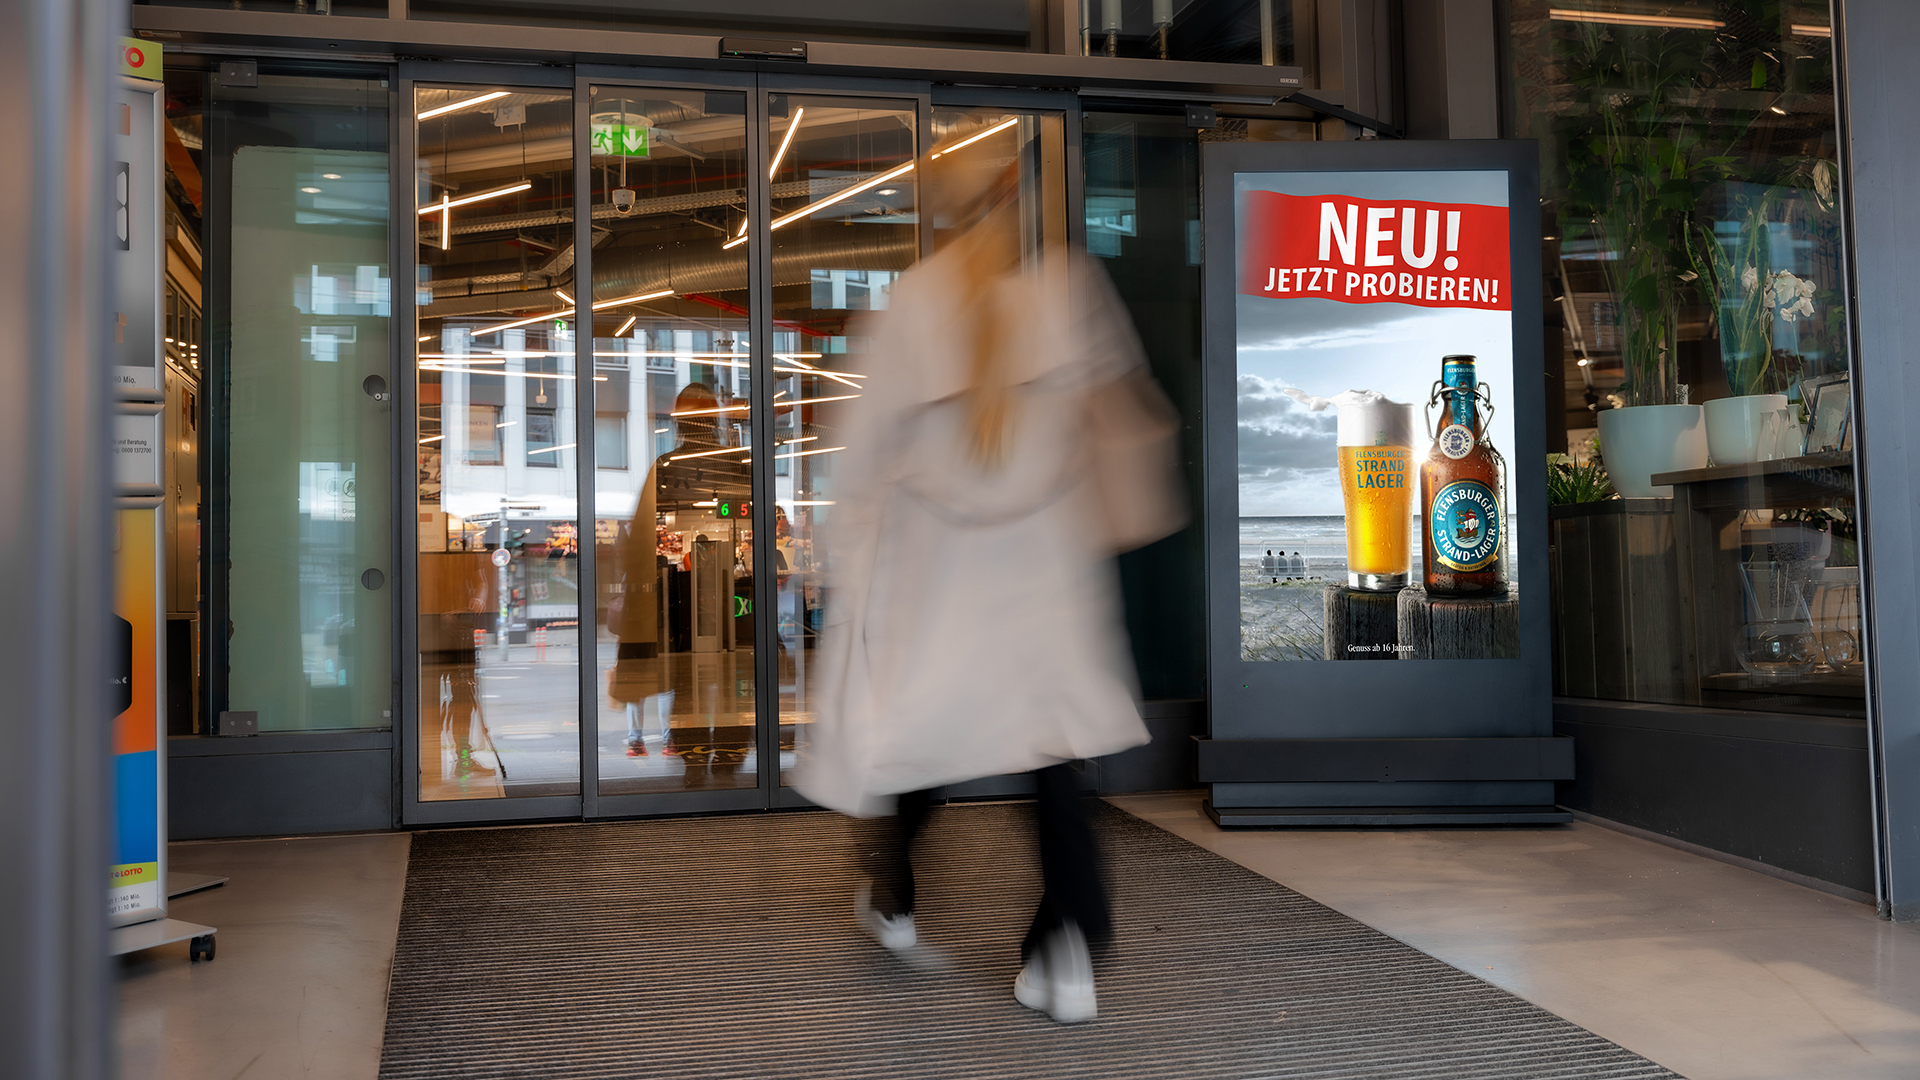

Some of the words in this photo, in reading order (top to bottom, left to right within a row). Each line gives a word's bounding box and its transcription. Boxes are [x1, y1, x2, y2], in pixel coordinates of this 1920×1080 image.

[1318, 202, 1461, 271] NEU!
[1264, 267, 1337, 292] JETZT
[1345, 272, 1498, 303] PROBIEREN!
[126, 439, 147, 447] Beratung
[1355, 450, 1405, 458] FLENSBURGER
[1356, 460, 1405, 472] STRAND
[1357, 473, 1404, 488] LAGER
[721, 503, 729, 516] 6
[740, 503, 748, 516] 5
[1436, 489, 1496, 521] FLENSBURGER
[1437, 528, 1496, 562] STRAND-LAGER
[1347, 643, 1371, 652] Genuss
[1372, 643, 1381, 652] ab
[1382, 643, 1391, 652] 16
[1391, 643, 1416, 654] Jahren.
[120, 867, 143, 877] LOTTO
